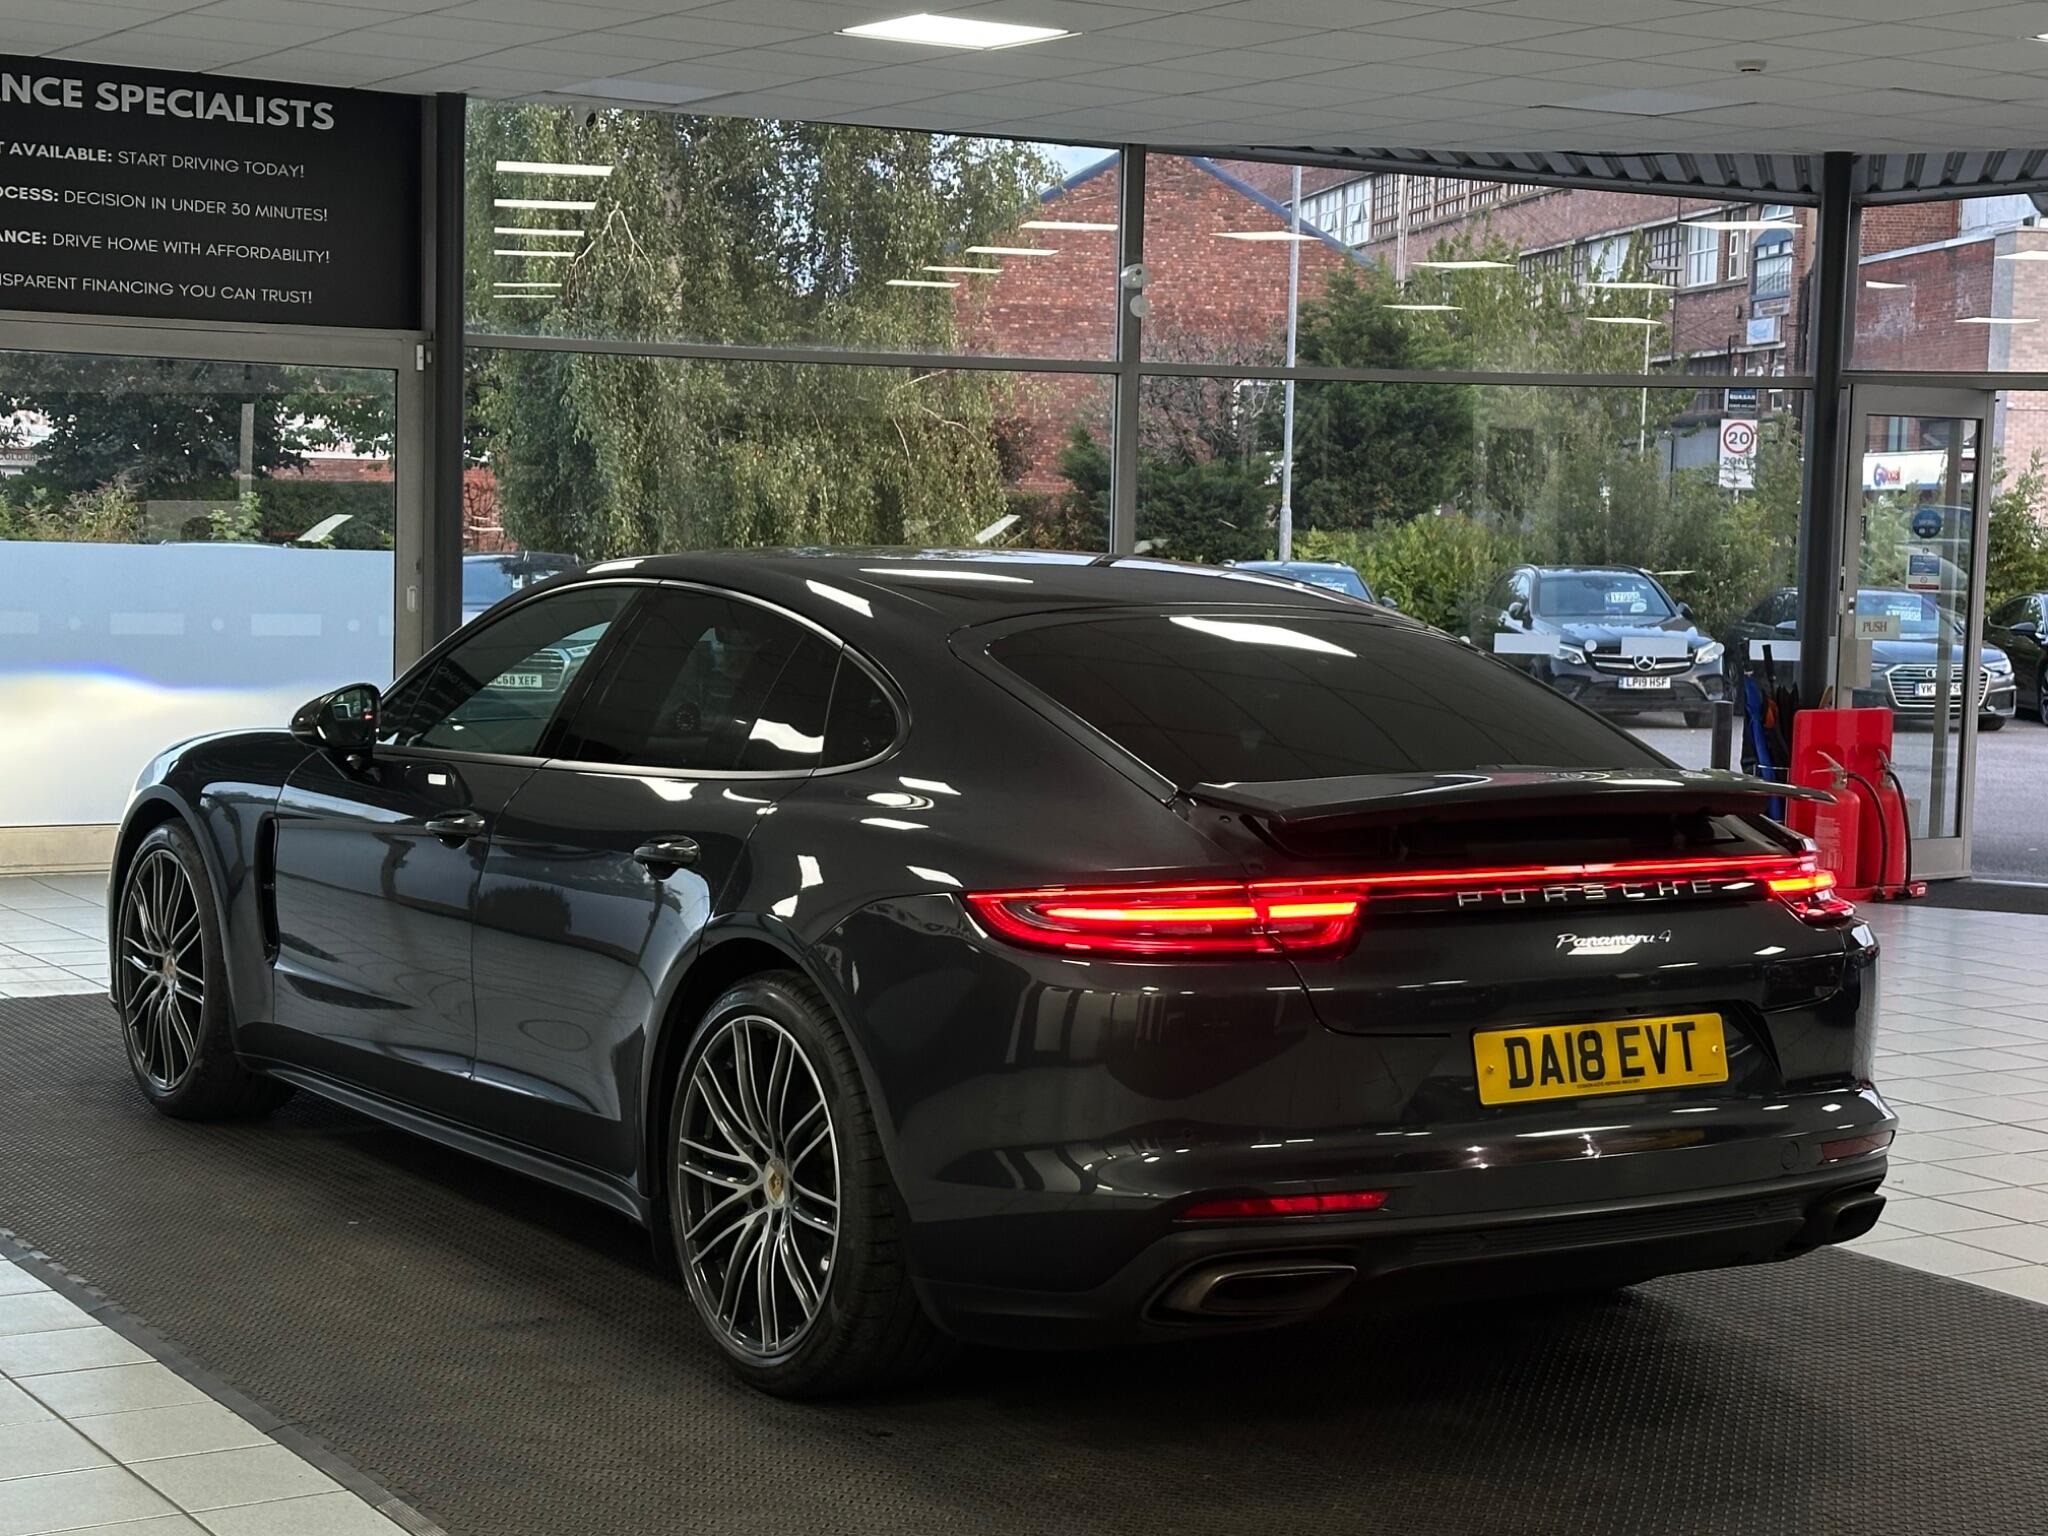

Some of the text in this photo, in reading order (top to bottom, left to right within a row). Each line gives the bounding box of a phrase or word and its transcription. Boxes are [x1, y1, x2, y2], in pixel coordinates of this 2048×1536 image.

[1, 73, 336, 129] NCE SPECIALISTS
[10, 143, 112, 162] AVAILABLE:
[119, 151, 166, 166] START
[173, 156, 238, 172] DRIVING
[245, 162, 303, 177] TODAY!
[0, 186, 327, 221] CESS: DECISION IN UNDER 30 MINUTES!
[0, 230, 329, 263] NCE: DRIVE HOME WITH AFFORDABILITY!
[0, 274, 311, 303] SPARENT FINANCING YOU CAN TRUST!
[1728, 431, 1750, 445] 20
[1862, 621, 1888, 633] PUSH
[518, 675, 538, 686] XEF
[1626, 676, 1648, 687] LP19
[1457, 880, 1713, 906] PORSCHE
[1556, 929, 1672, 949] Panamera 4
[1504, 1021, 1696, 1089] DA18 EVT
